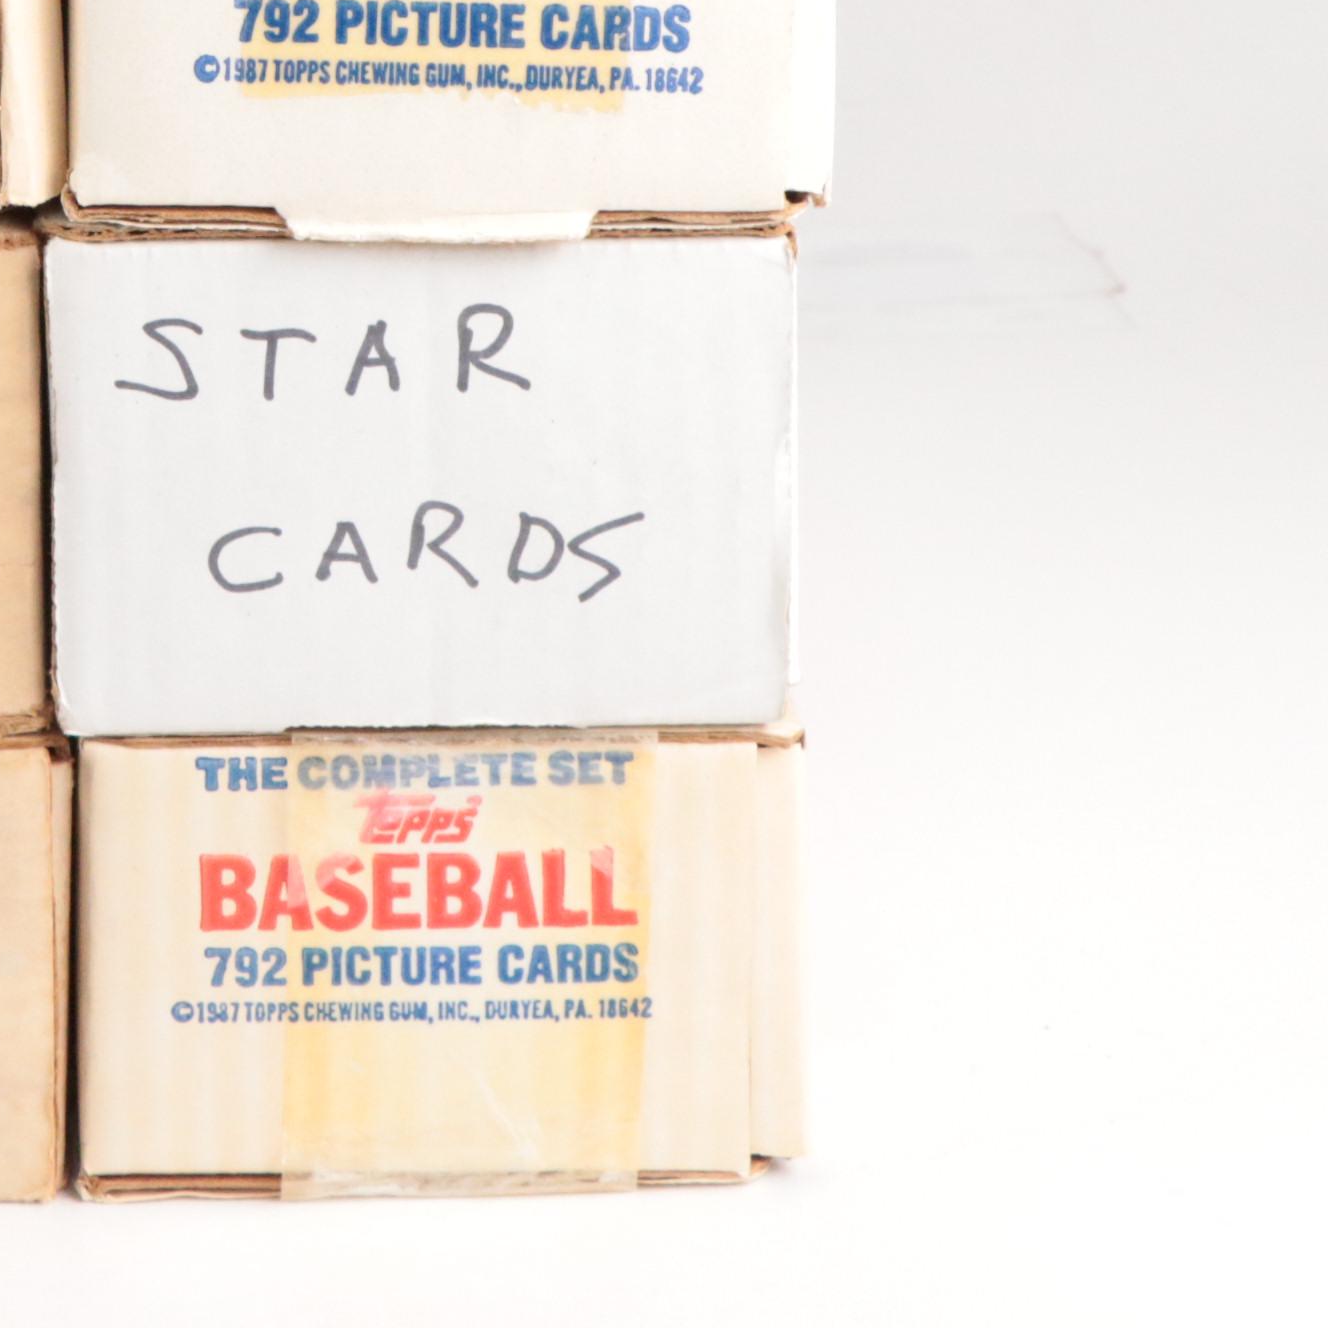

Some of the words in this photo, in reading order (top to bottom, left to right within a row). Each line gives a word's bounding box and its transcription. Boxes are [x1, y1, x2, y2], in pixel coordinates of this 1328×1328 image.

[539, 2, 692, 54] CARDS
[272, 59, 331, 85] TOPPS
[335, 59, 421, 86] CHEWING
[424, 62, 473, 91] GUM,
[524, 64, 606, 94] DURYEA,
[609, 66, 641, 91] PA.
[644, 66, 705, 95] 18642
[114, 302, 533, 401] STAR
[206, 499, 646, 603] CARDS
[194, 755, 289, 792] THE
[296, 751, 538, 791] COMPLETE
[547, 749, 635, 787] SET
[199, 845, 639, 933] BASEBALL
[203, 946, 289, 988] 792
[301, 945, 483, 987] PICTURE
[496, 942, 640, 986] CARDS
[244, 1001, 300, 1023] TOPPS
[303, 1000, 385, 1022] CHEWING
[388, 1000, 435, 1024] GUM,
[484, 999, 561, 1023] DURYEA,
[564, 998, 594, 1020] PA.
[598, 997, 654, 1020] 18642
